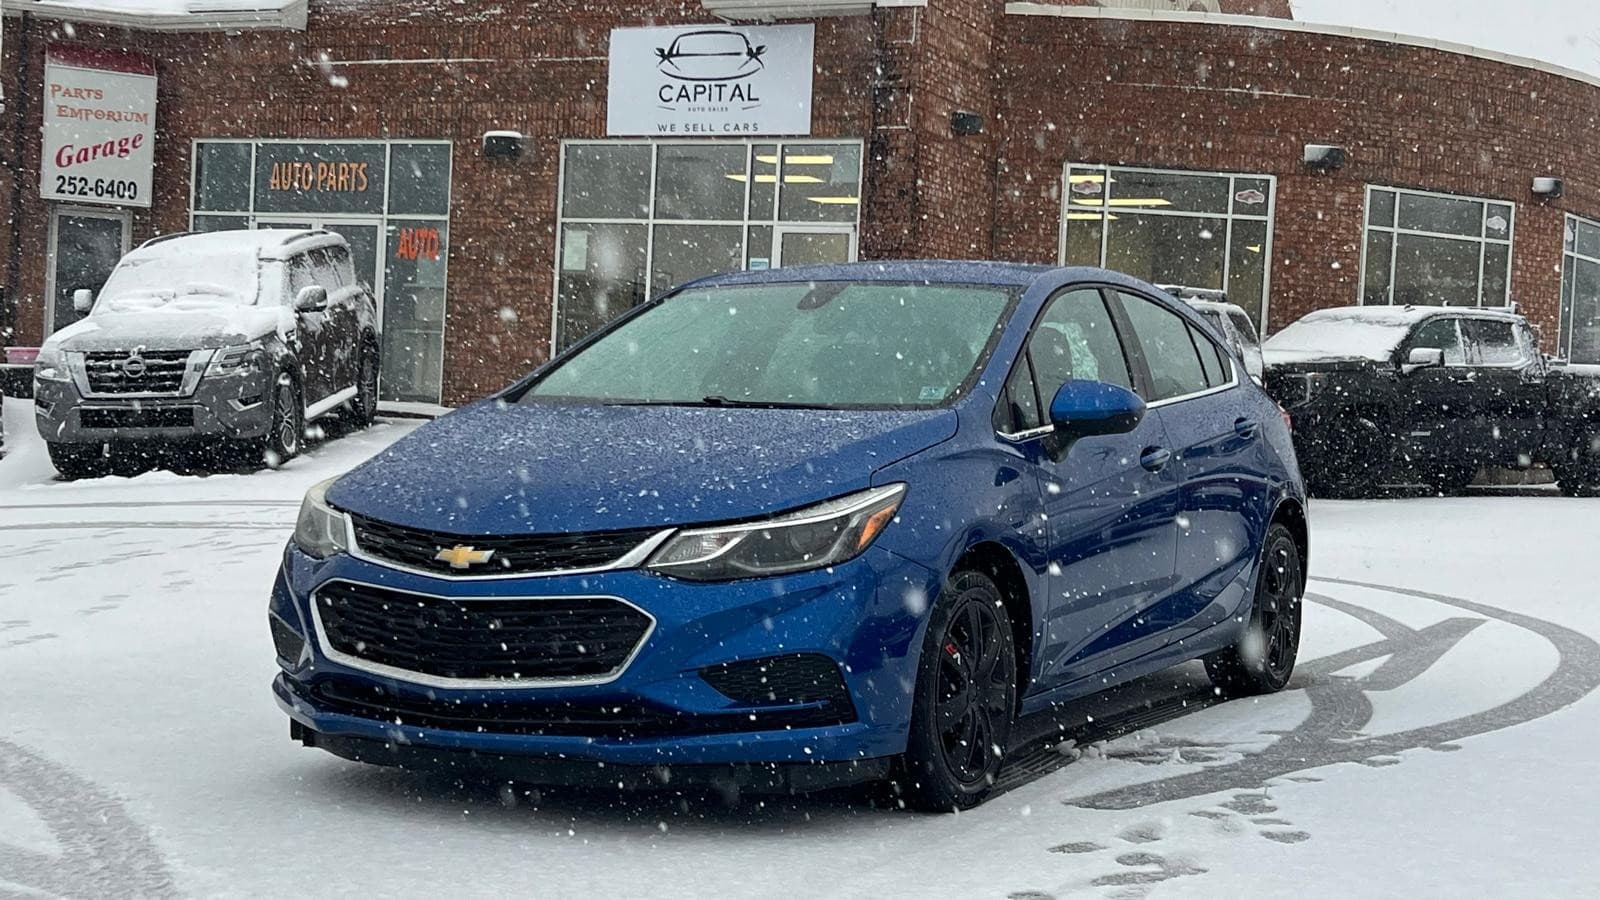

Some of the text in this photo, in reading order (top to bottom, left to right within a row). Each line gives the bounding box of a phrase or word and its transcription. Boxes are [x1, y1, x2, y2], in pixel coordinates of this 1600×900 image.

[659, 83, 759, 102] CAPITAL
[657, 122, 759, 132] WE SELL CARS
[55, 133, 144, 168] Garage
[55, 175, 138, 200] 252-6400
[270, 161, 369, 192] AUTO PARTS
[396, 227, 440, 261] AUTO
